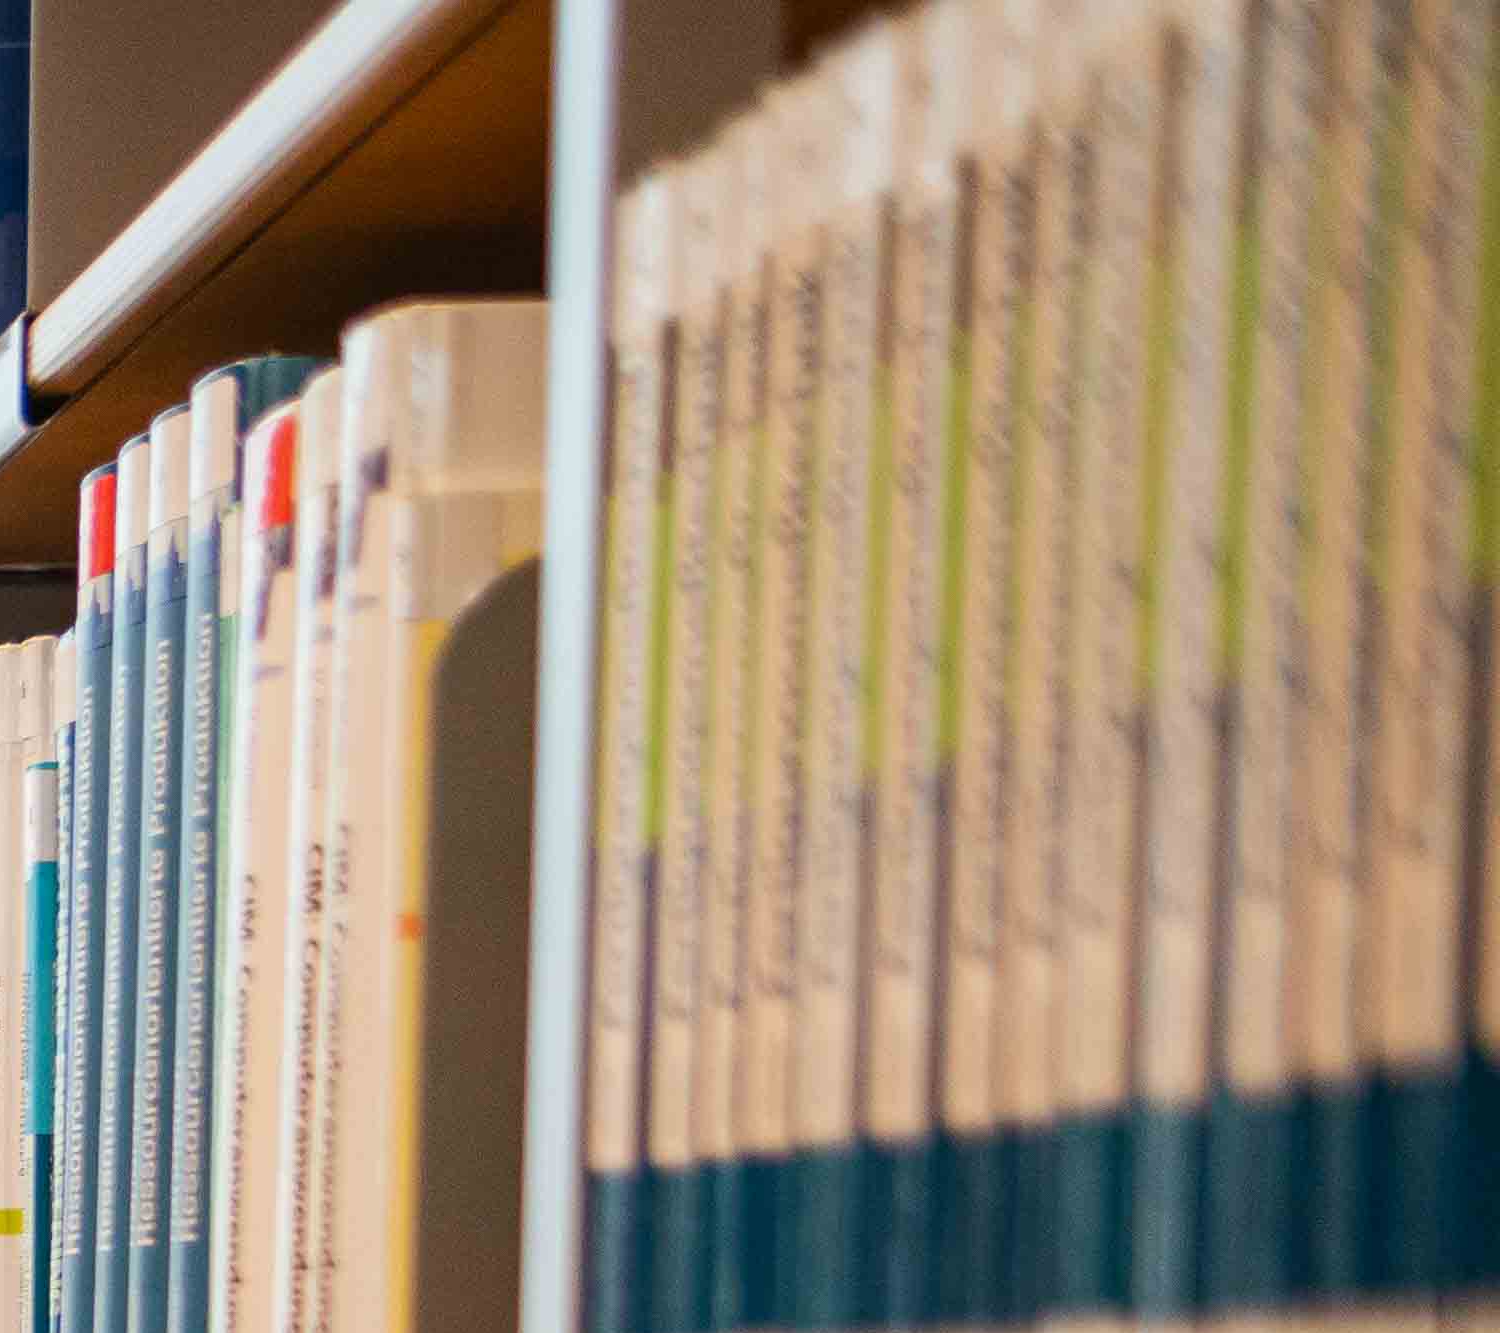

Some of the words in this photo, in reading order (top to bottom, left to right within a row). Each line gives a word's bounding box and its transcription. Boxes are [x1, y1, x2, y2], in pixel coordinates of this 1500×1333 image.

[73, 687, 95, 871] Produktion
[149, 639, 171, 834] Produktion
[191, 614, 215, 816] Produktion
[67, 883, 89, 1255] Ressourcenorientierte
[137, 851, 164, 1246] Ressourcenorientierte
[178, 831, 208, 1243] Ressourcenorientierte
